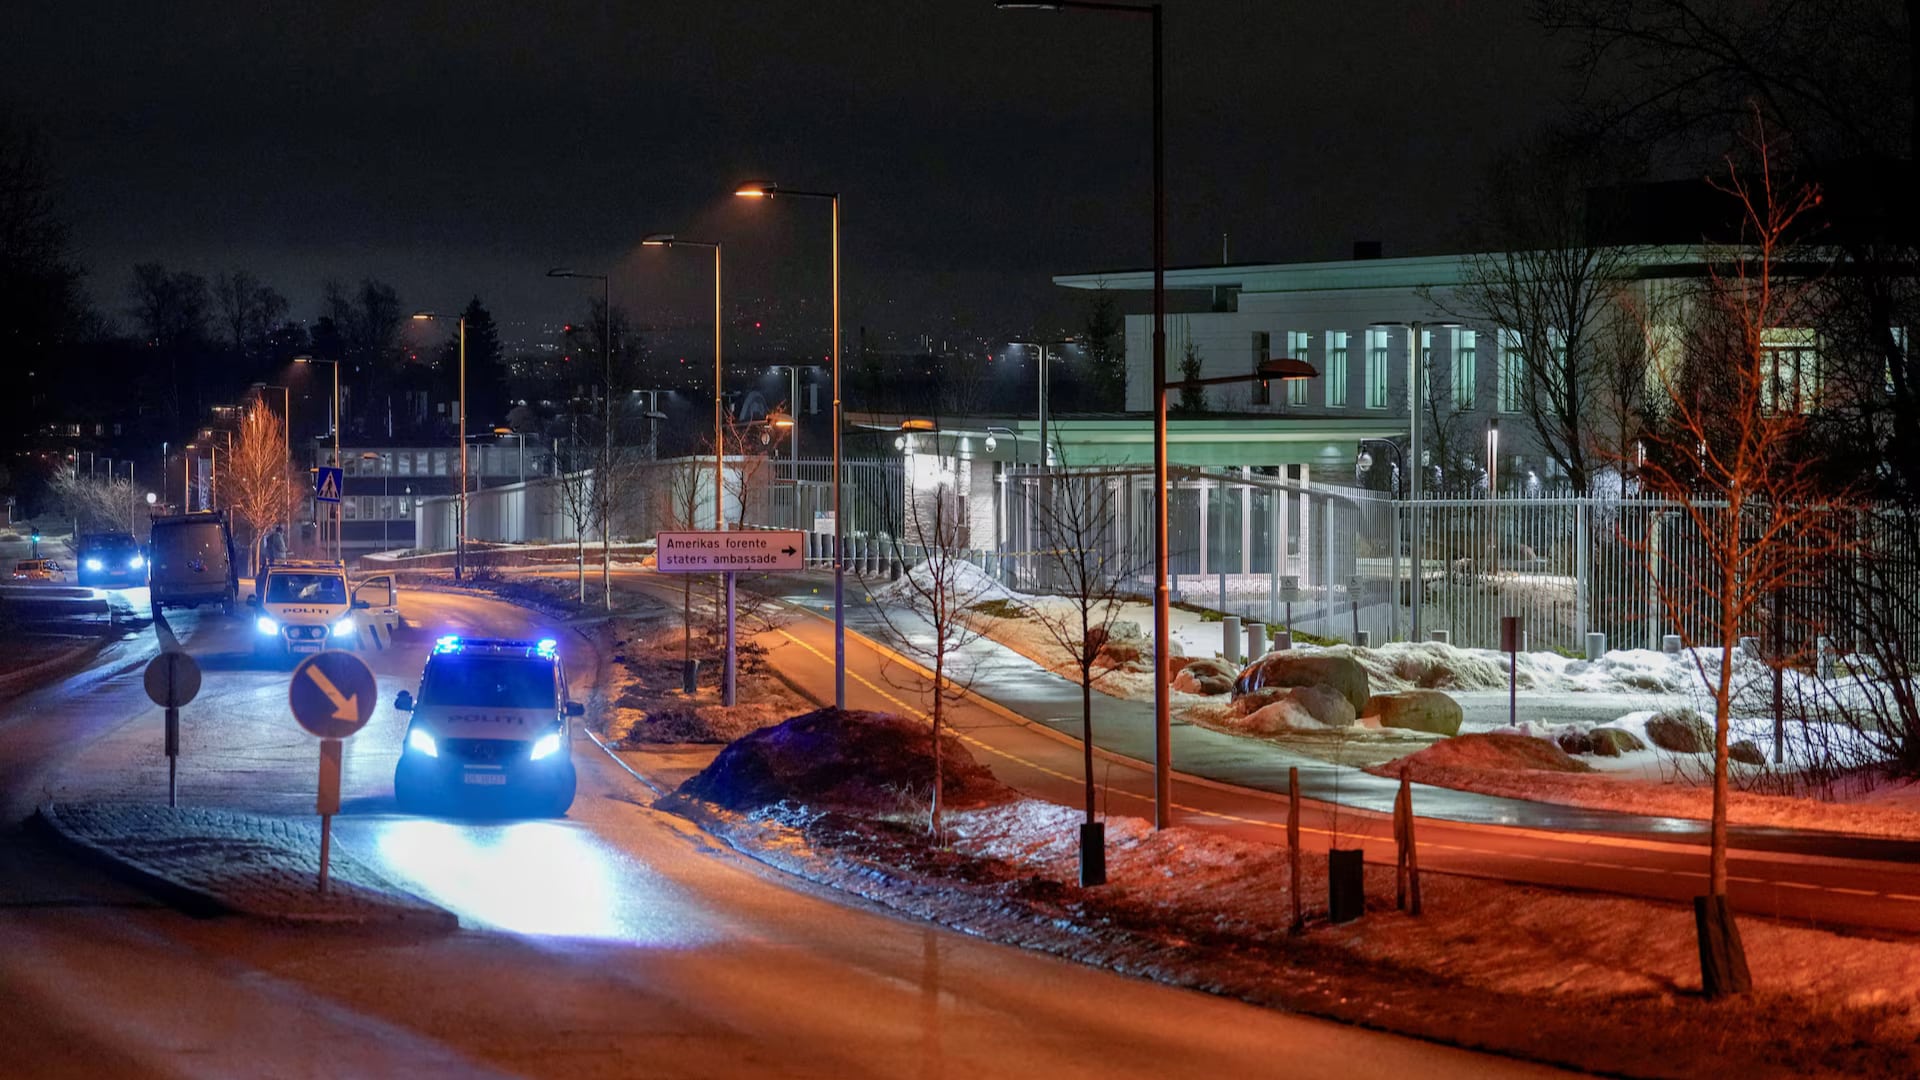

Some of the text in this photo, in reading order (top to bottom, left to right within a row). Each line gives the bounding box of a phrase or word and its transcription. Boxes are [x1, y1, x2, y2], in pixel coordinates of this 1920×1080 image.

[666, 538, 767, 549] Amerikas forente
[666, 553, 777, 564] staters ambassade
[282, 607, 329, 615] POLITI
[447, 713, 524, 726] POLITI
